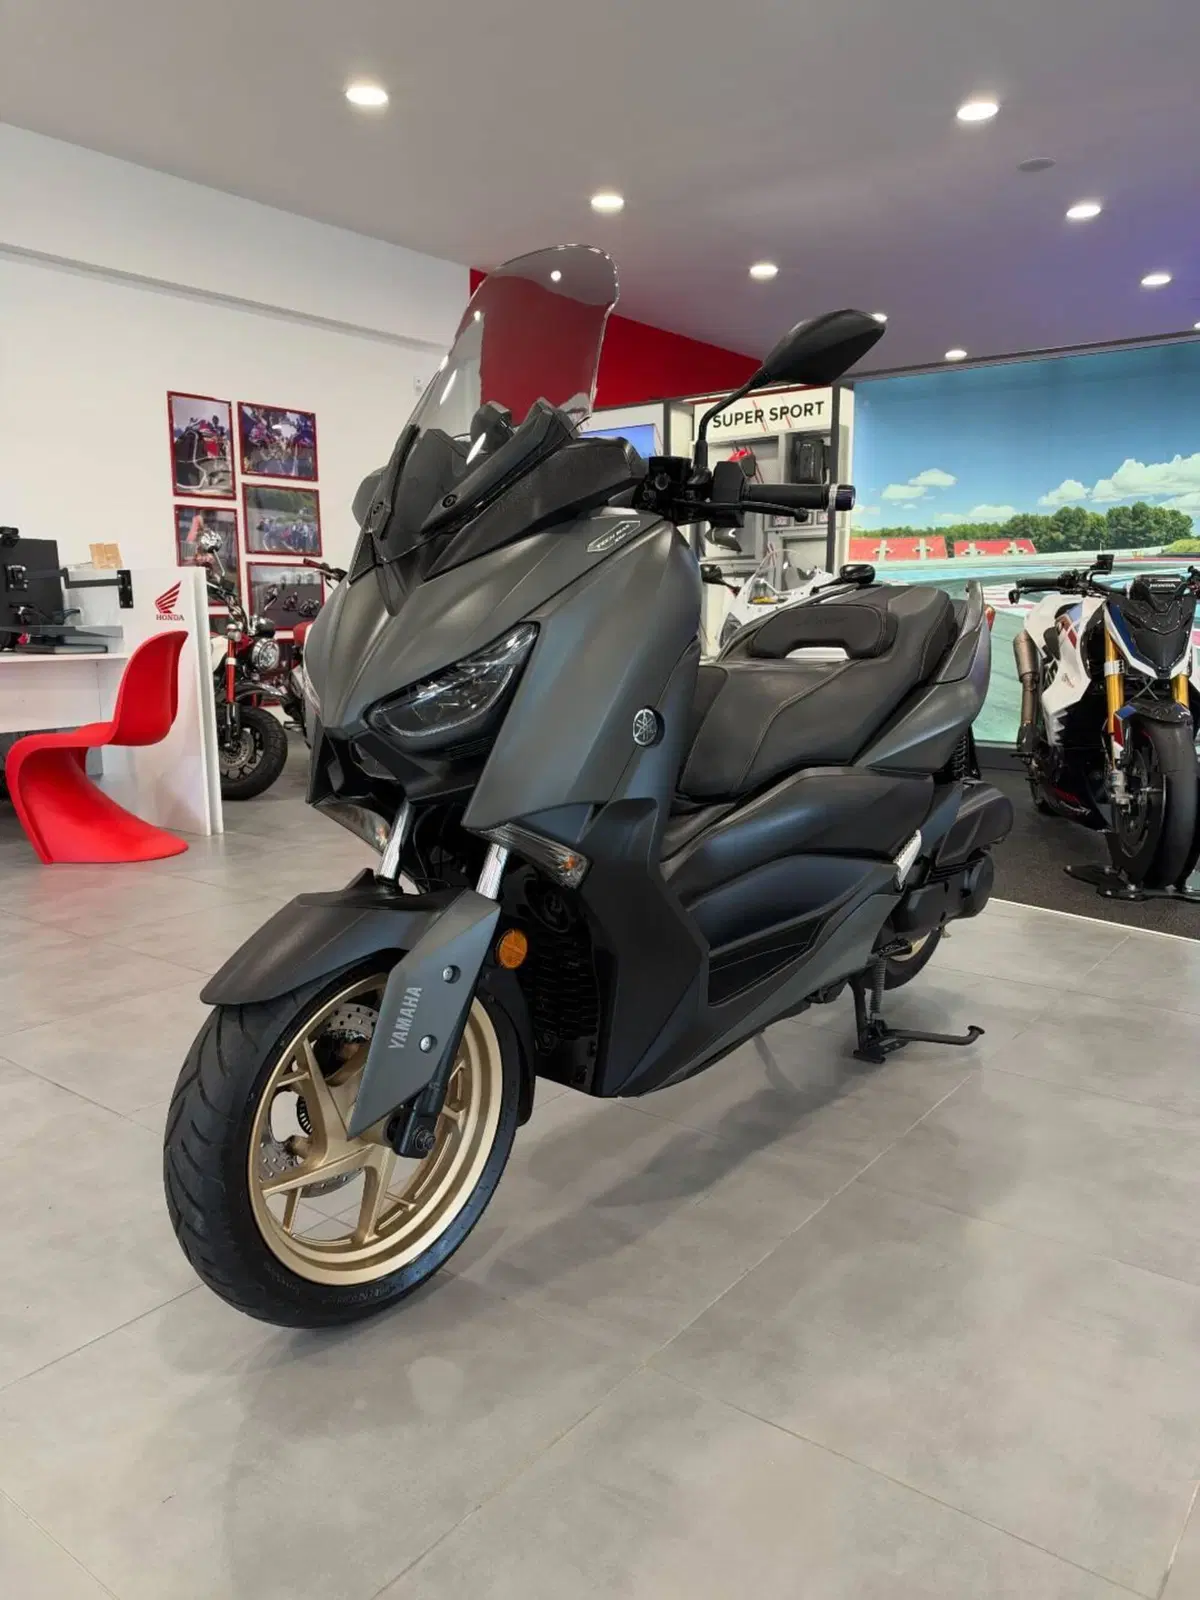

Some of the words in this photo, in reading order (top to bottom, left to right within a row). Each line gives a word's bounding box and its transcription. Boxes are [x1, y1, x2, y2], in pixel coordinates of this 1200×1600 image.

[713, 409, 764, 428] SUPER
[769, 401, 824, 421] SPORT
[388, 987, 422, 1048] YAMAHA
